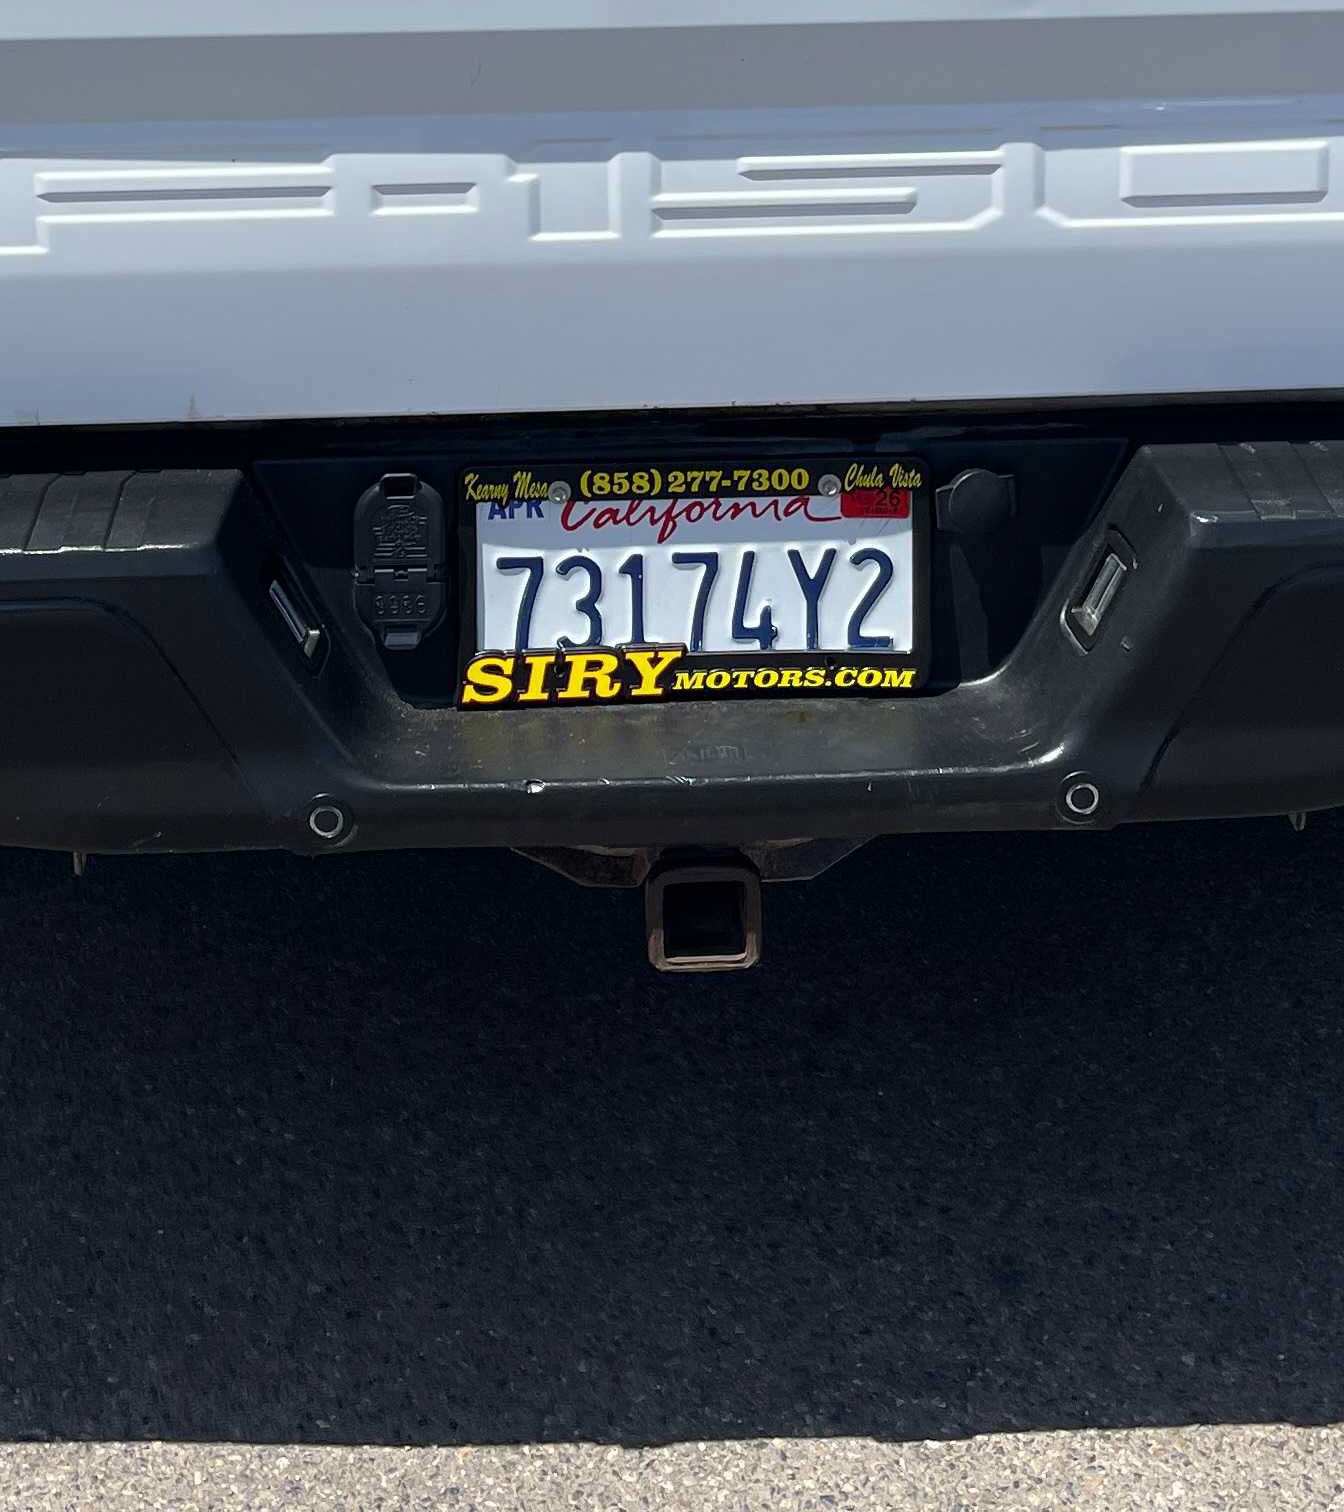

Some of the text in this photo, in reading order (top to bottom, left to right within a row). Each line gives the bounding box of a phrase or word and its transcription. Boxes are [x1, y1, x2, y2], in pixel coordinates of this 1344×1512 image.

[464, 471, 549, 506] Kearny Mesa
[579, 468, 810, 499] (858) 277-7300
[845, 464, 922, 492] Chula Vista
[488, 499, 544, 520] APR
[560, 496, 843, 544] California
[496, 548, 894, 652] 73174Y2
[460, 649, 916, 704] SIRY MOTORS.COM
